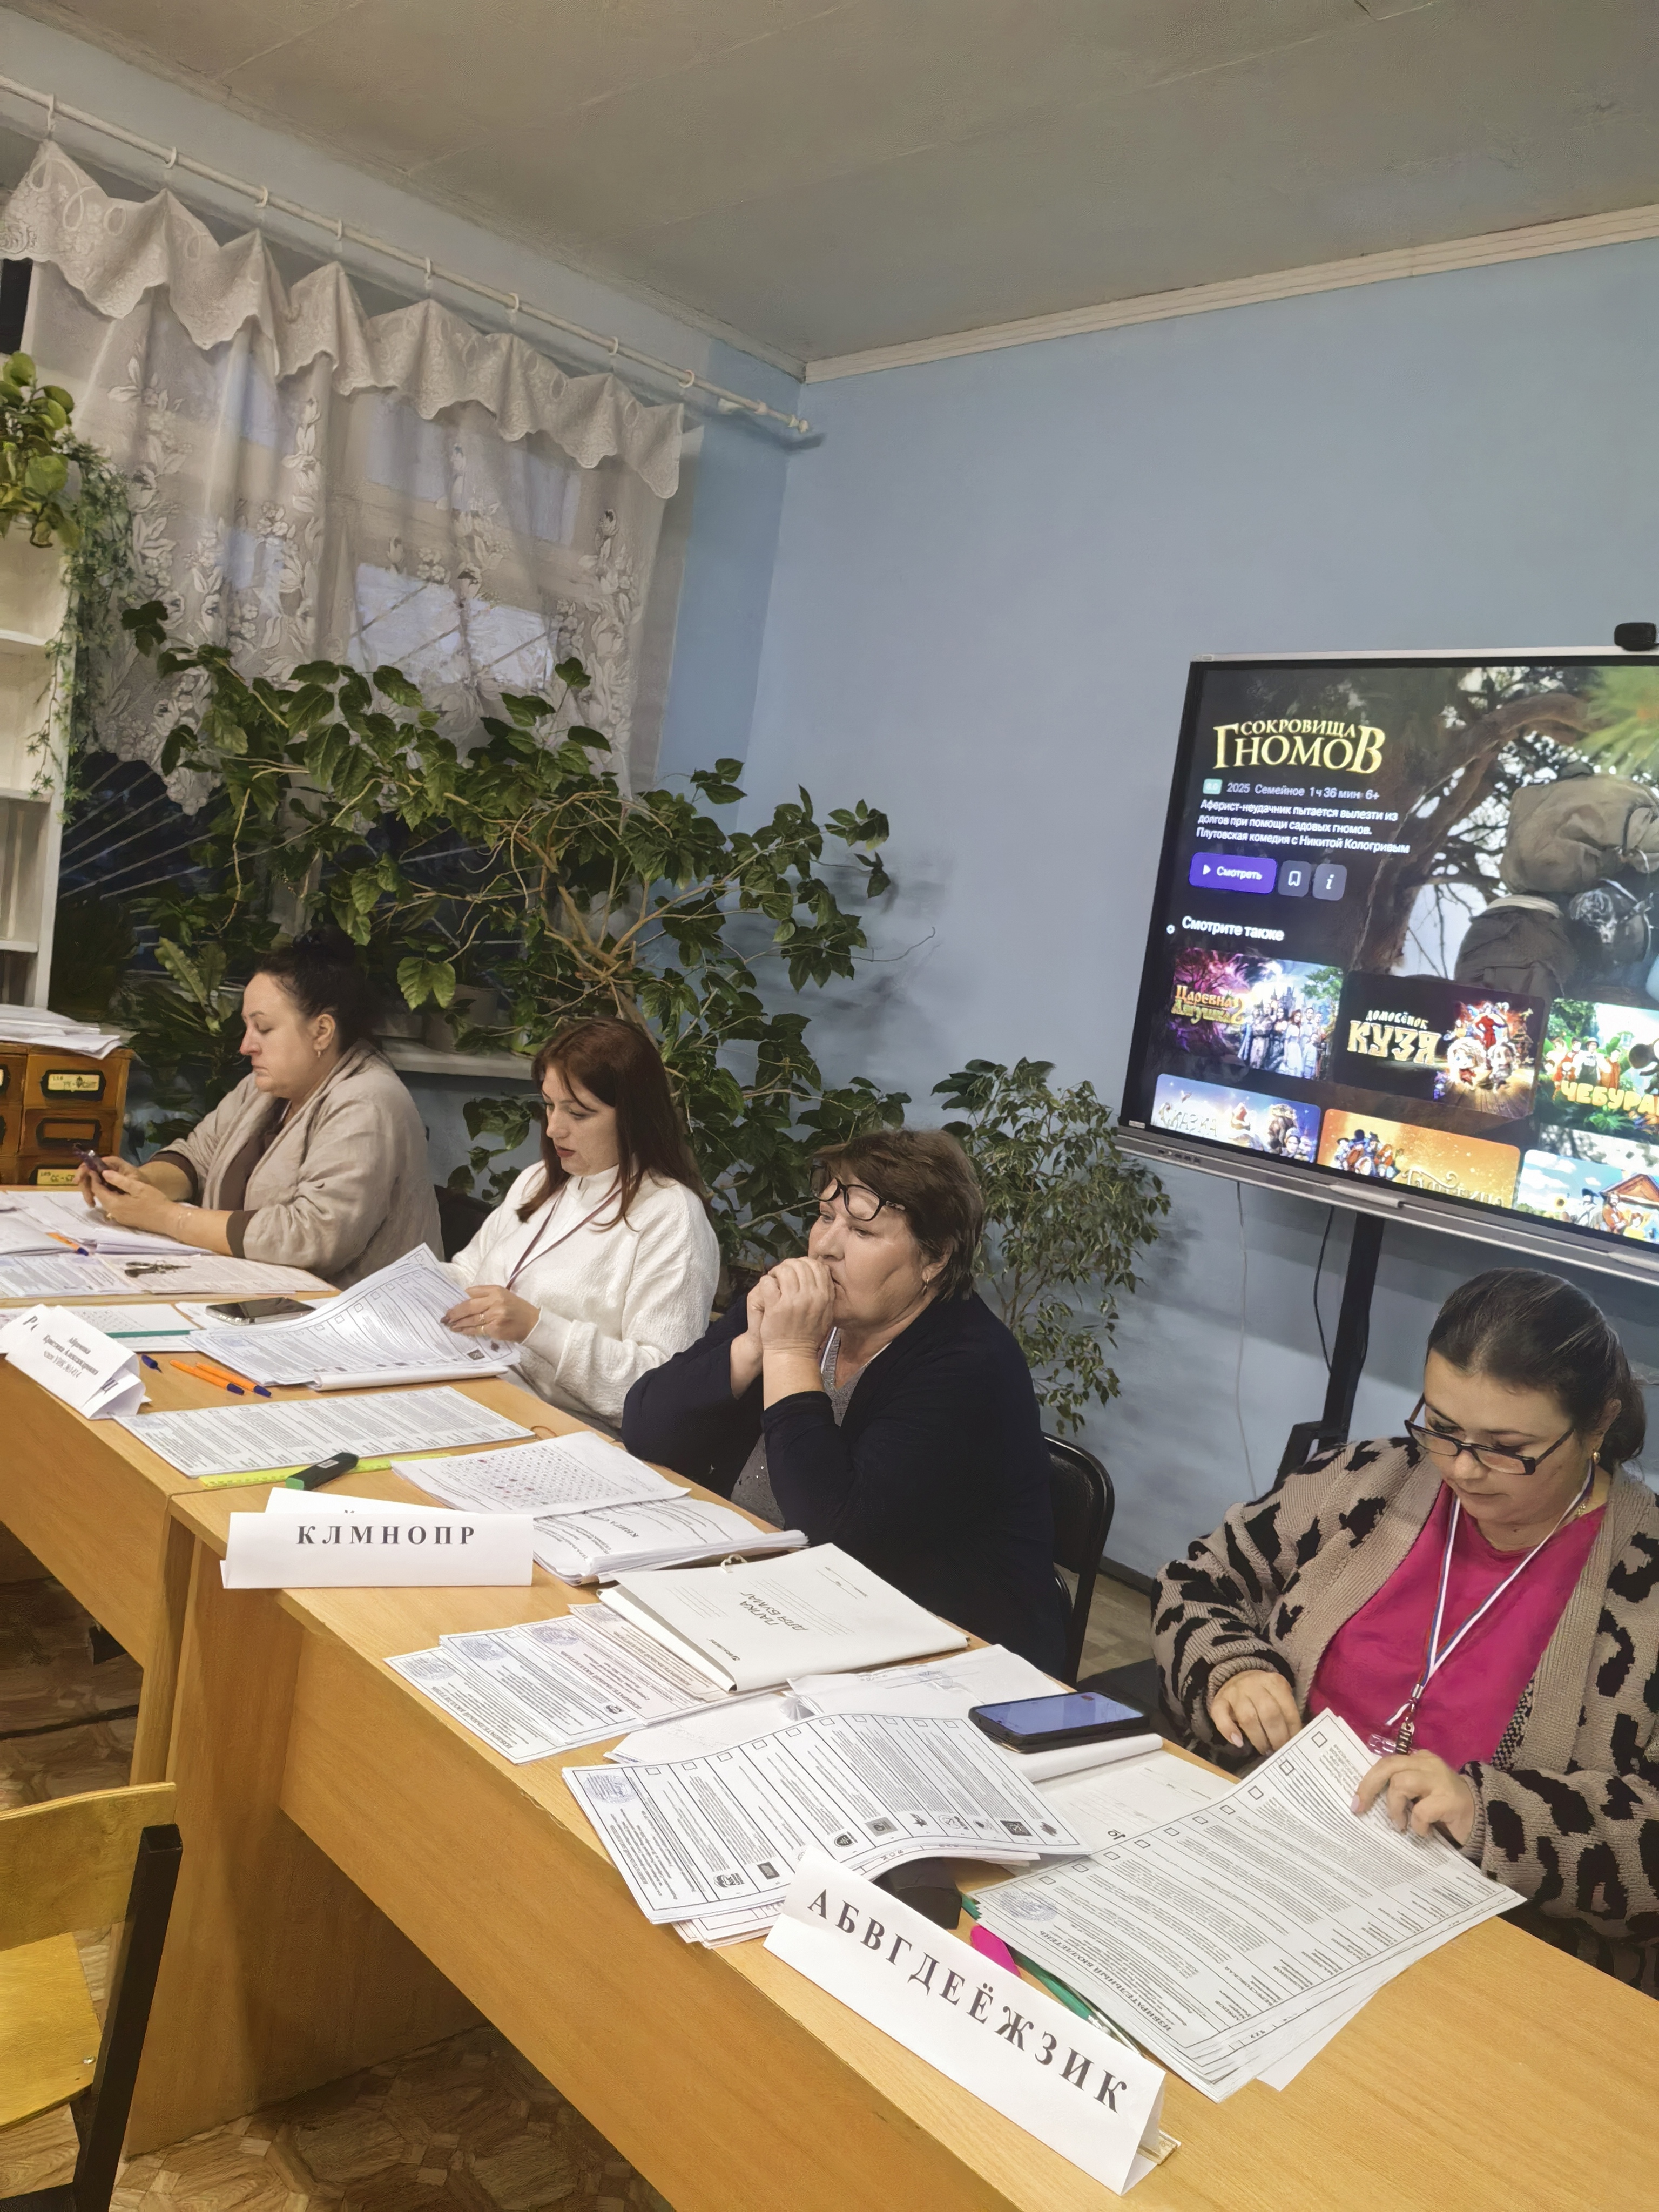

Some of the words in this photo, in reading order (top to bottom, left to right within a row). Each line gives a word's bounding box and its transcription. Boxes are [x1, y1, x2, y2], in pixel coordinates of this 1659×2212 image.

[1240, 719, 1356, 738] СОКРОВИЩА
[1212, 723, 1386, 774] ГНОМОВ
[1226, 782, 1251, 793] 2025
[1255, 784, 1305, 797] Семейное
[1324, 787, 1337, 798] 36
[1338, 791, 1361, 799] мин
[1365, 789, 1380, 800] 6+
[1200, 799, 1292, 815] Аферист-неудачник
[1293, 807, 1338, 818] пытается
[1340, 810, 1382, 820] вылезти
[1385, 812, 1399, 821] из
[1197, 814, 1230, 826] долгов
[1230, 817, 1247, 828] при
[1249, 819, 1287, 830] помощи
[1289, 821, 1331, 833] садовых
[1196, 827, 1248, 840] Плутовская
[1249, 832, 1290, 845] комедия
[1291, 837, 1298, 845] с
[1299, 835, 1343, 848] Никитой
[1344, 838, 1411, 854] Кологривым
[1217, 866, 1263, 880] Смотреть
[1182, 915, 1243, 937] Смотрите
[1244, 926, 1285, 941] также
[1347, 1020, 1442, 1066] КУЗЯ
[1561, 1080, 1659, 1116] ЧЕБУРА
[296, 1525, 475, 1545] КЛМНОПР
[739, 1591, 781, 1615] БУМАГ
[739, 1600, 779, 1625] ПАПКА
[775, 1616, 810, 1630] ДЛЯ
[1037, 1930, 1094, 1967] БЮЛЛЕТЕНЬ
[807, 1889, 1127, 2113] АБВГДЕЁЖЗИК
[1091, 1967, 1172, 2031] ИЗБИРАТЕЛЬНЫЙ
